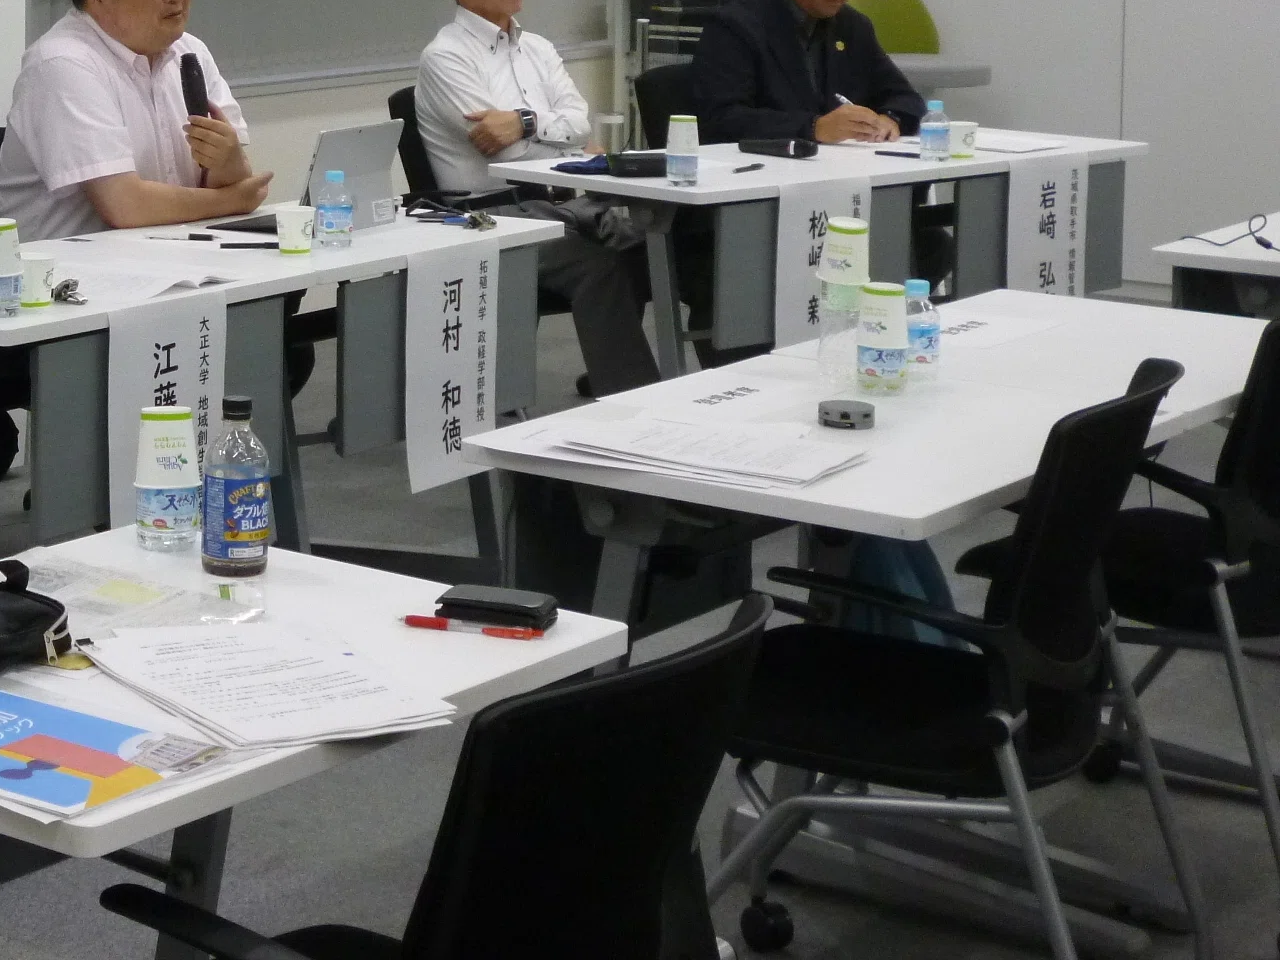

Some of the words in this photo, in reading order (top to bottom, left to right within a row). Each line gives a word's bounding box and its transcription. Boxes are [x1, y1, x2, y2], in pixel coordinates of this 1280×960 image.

[1039, 261, 1056, 294] 弘
[199, 316, 210, 386] 大正大学
[442, 278, 464, 354] 河村
[441, 379, 463, 455] 和徳
